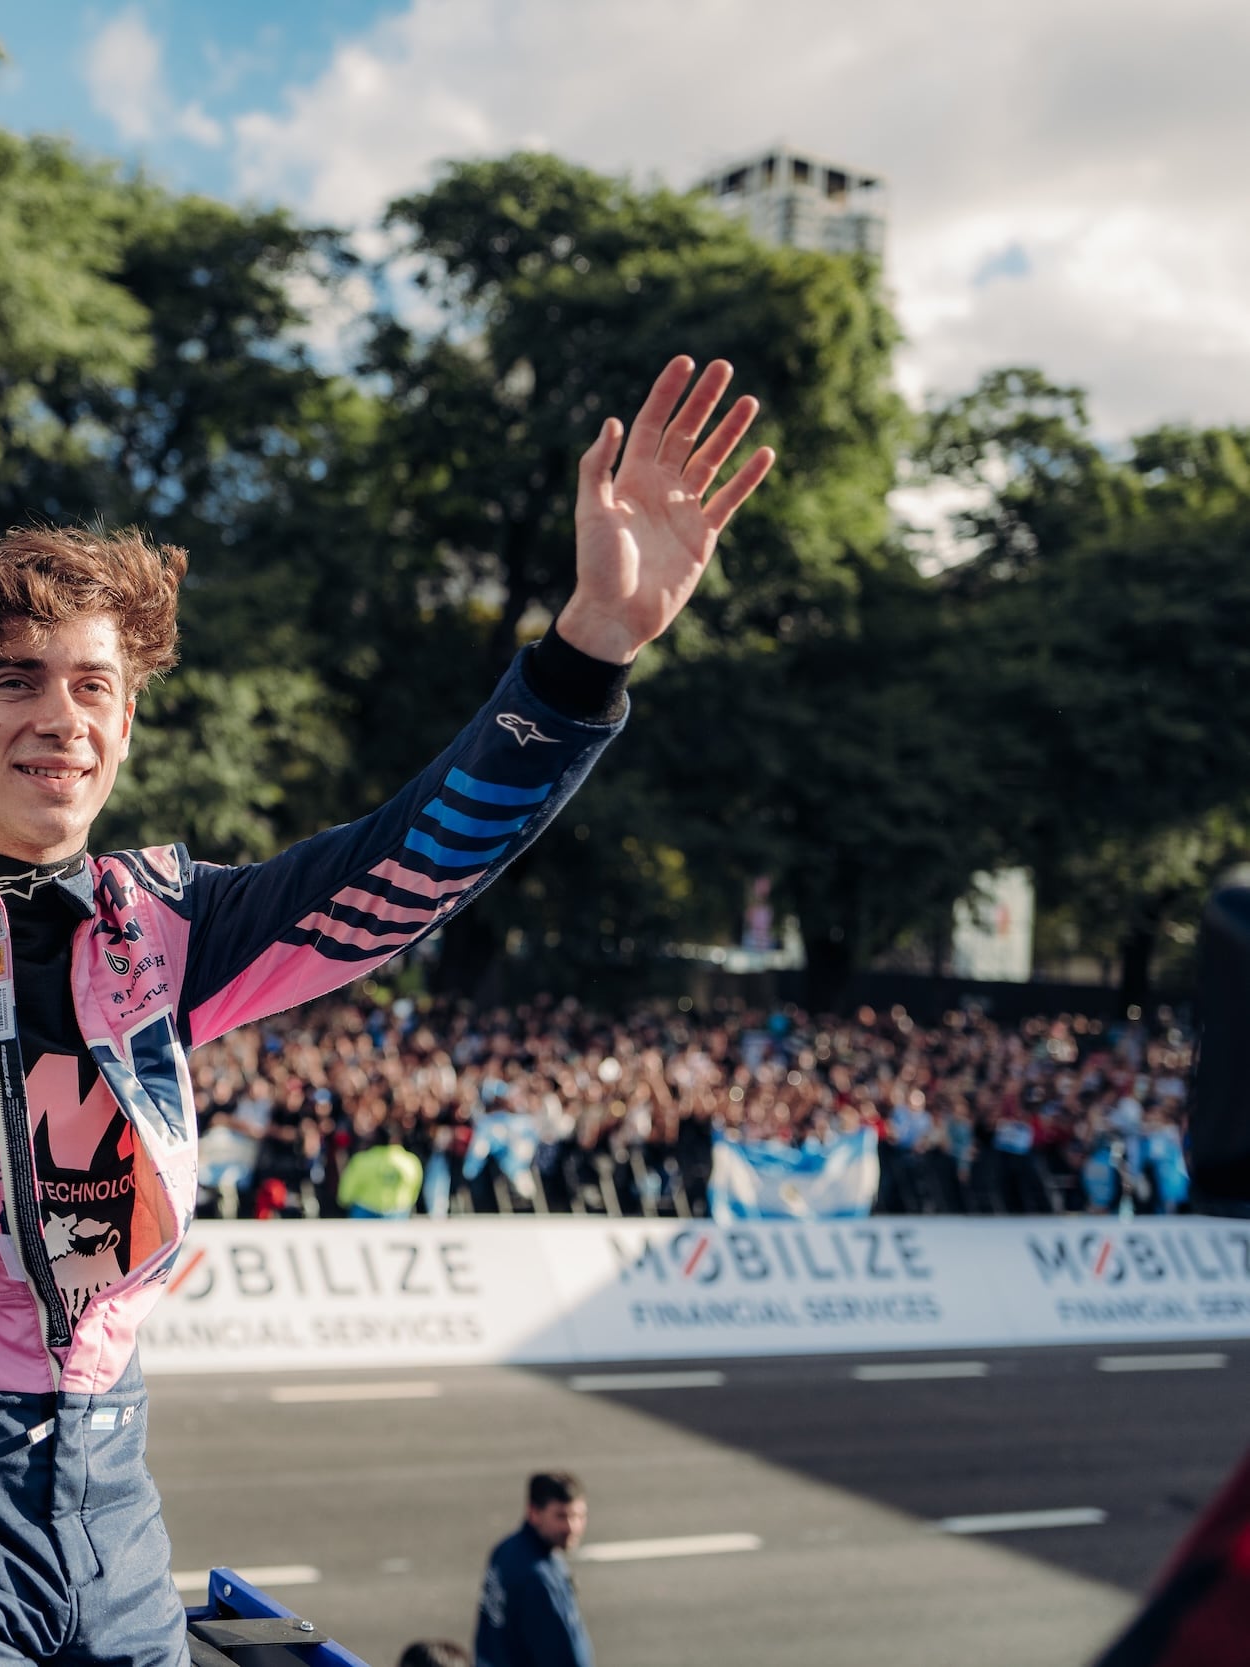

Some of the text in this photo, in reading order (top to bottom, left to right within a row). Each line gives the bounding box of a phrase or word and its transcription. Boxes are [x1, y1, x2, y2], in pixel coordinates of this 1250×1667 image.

[38, 1171, 136, 1203] TECHNOLO
[165, 1240, 483, 1301] OBILIZE
[608, 1227, 937, 1285] MOBILIZE
[1025, 1229, 1250, 1287] MOBILIZ
[137, 1310, 486, 1350] NANCIAL SERVICES
[628, 1292, 944, 1330] FINANCIAL SERVICES
